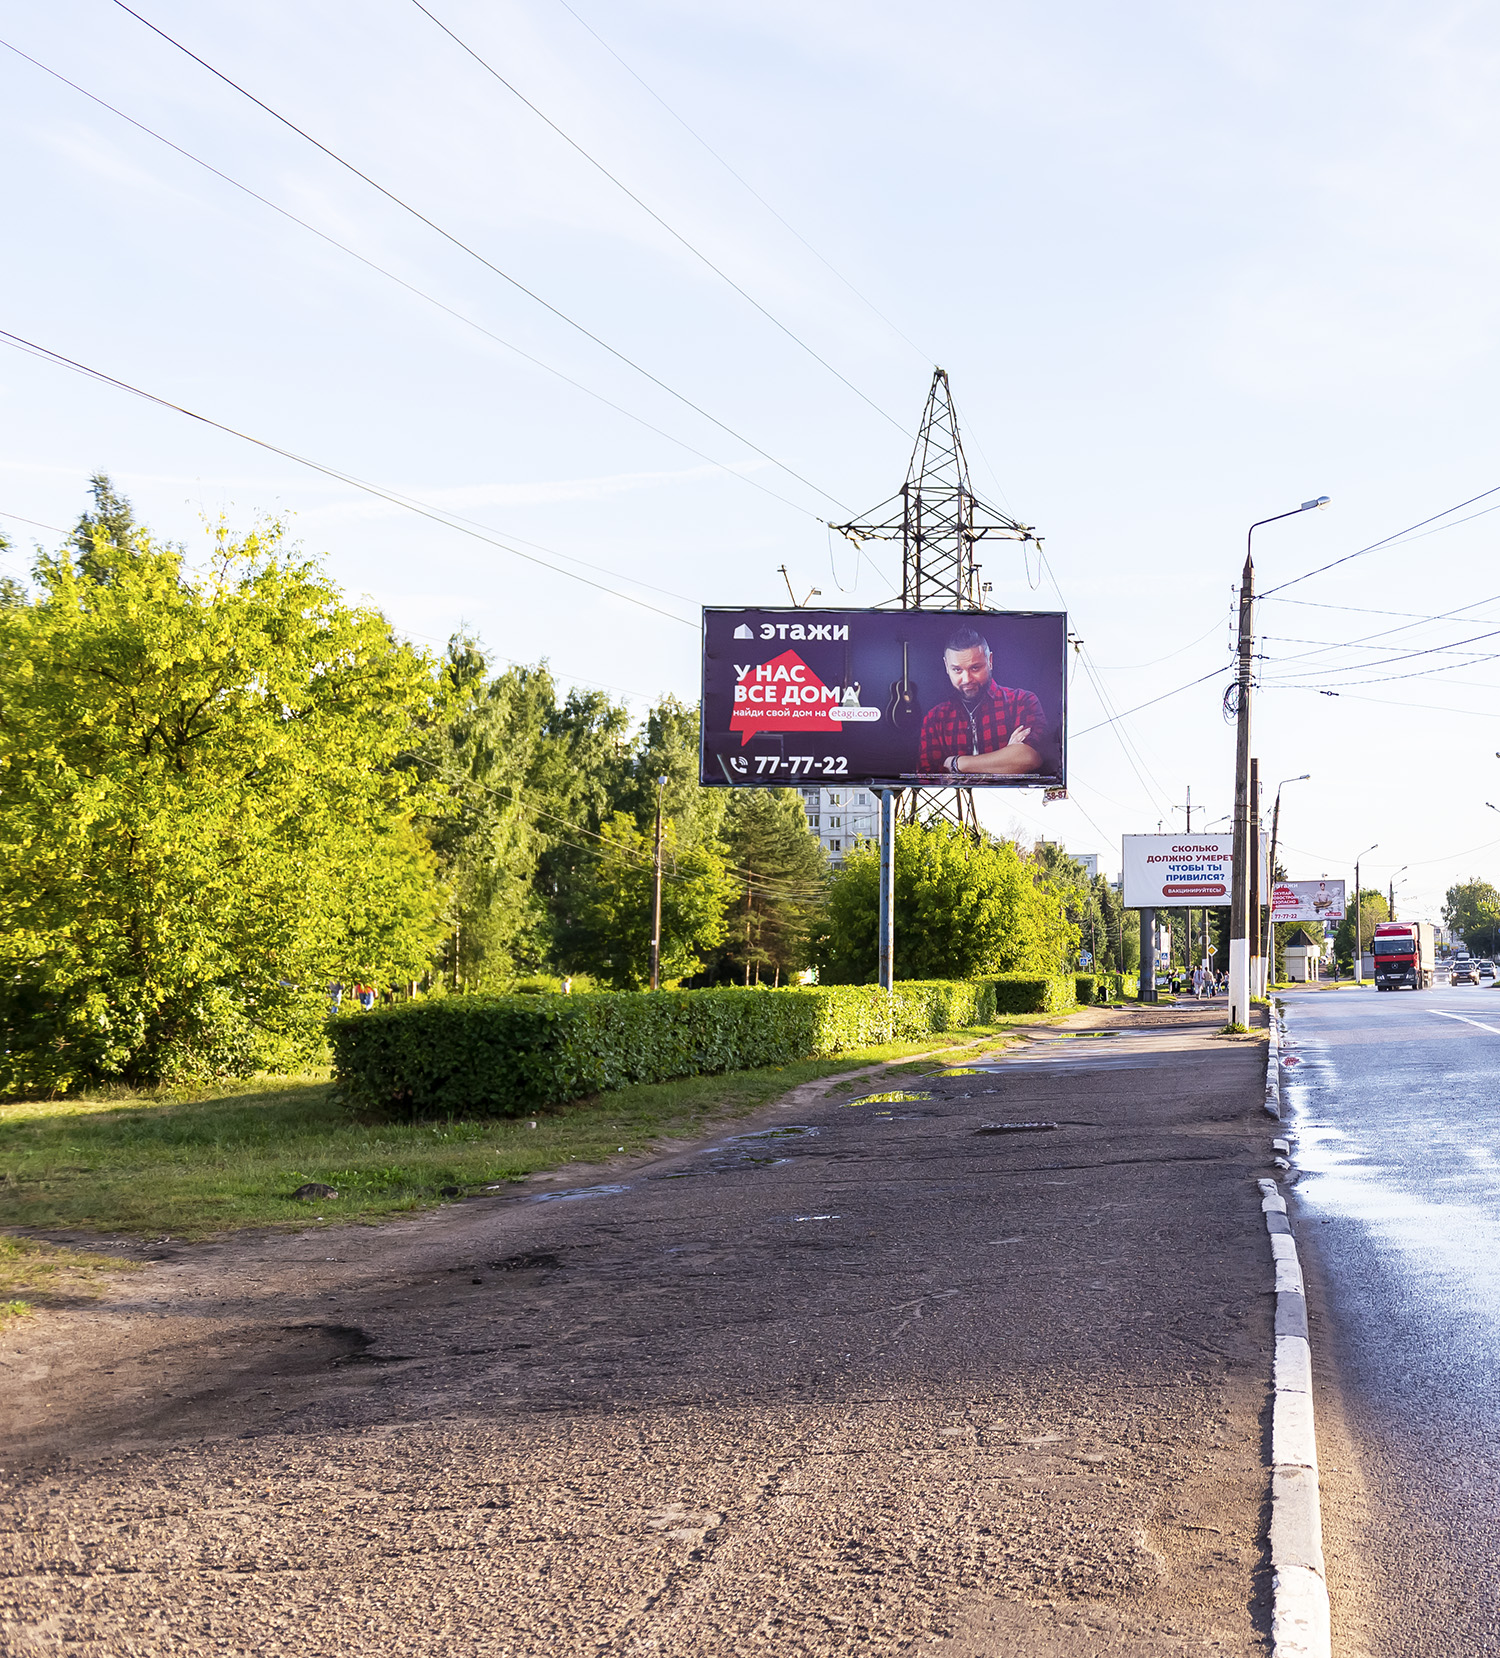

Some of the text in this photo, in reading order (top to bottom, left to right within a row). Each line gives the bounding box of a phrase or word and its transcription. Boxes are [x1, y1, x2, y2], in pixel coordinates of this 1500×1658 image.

[733, 664, 806, 683] У НАС
[734, 685, 859, 706] ВСЕ ДОМА
[732, 708, 764, 718] найди
[766, 708, 791, 717] свой
[792, 710, 813, 718] дом
[831, 709, 879, 720] etagi.com
[754, 756, 849, 774] 77-77-22
[1171, 844, 1219, 853] СКОЛЬКО
[1146, 854, 1234, 863] ДОЛЖНО УМЕРЕТ
[1168, 864, 1204, 872] ЧТОБЫ
[1166, 873, 1225, 881] ПРИВИЛСЯ?
